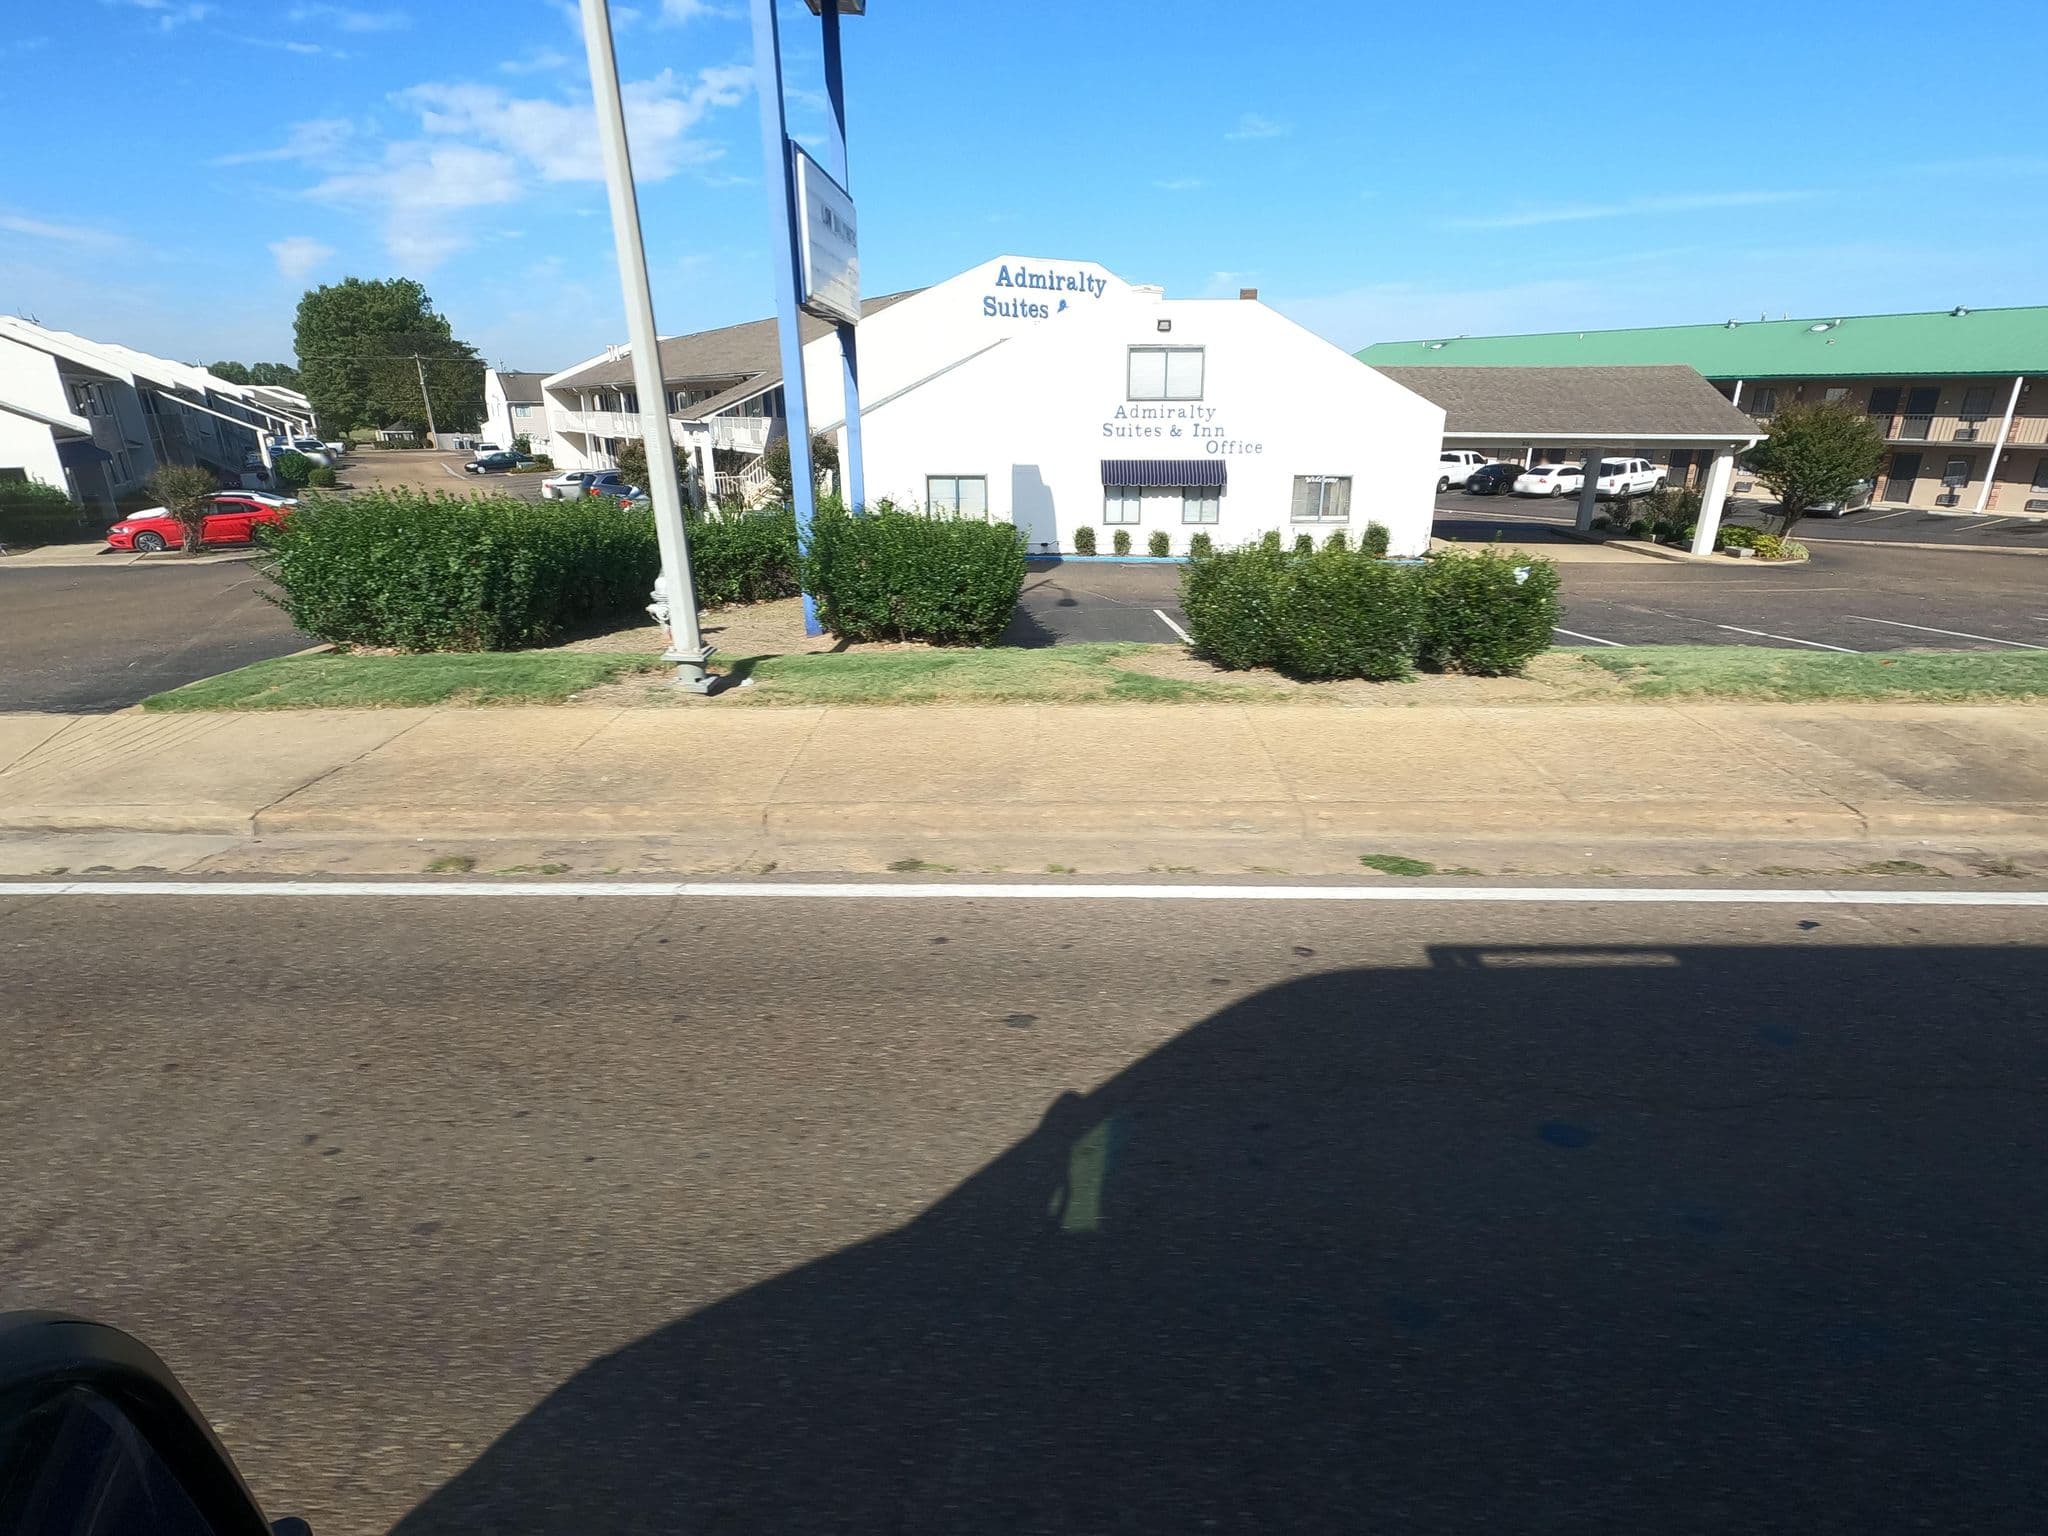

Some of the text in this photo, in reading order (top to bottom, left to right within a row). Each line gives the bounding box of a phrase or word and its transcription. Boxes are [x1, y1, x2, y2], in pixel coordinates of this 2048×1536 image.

[995, 265, 1107, 299] Admiralty
[983, 296, 1049, 320] Suites
[1113, 404, 1217, 423] Admiralty
[1102, 422, 1225, 438] Suites & Inn
[1206, 440, 1263, 455] Office
